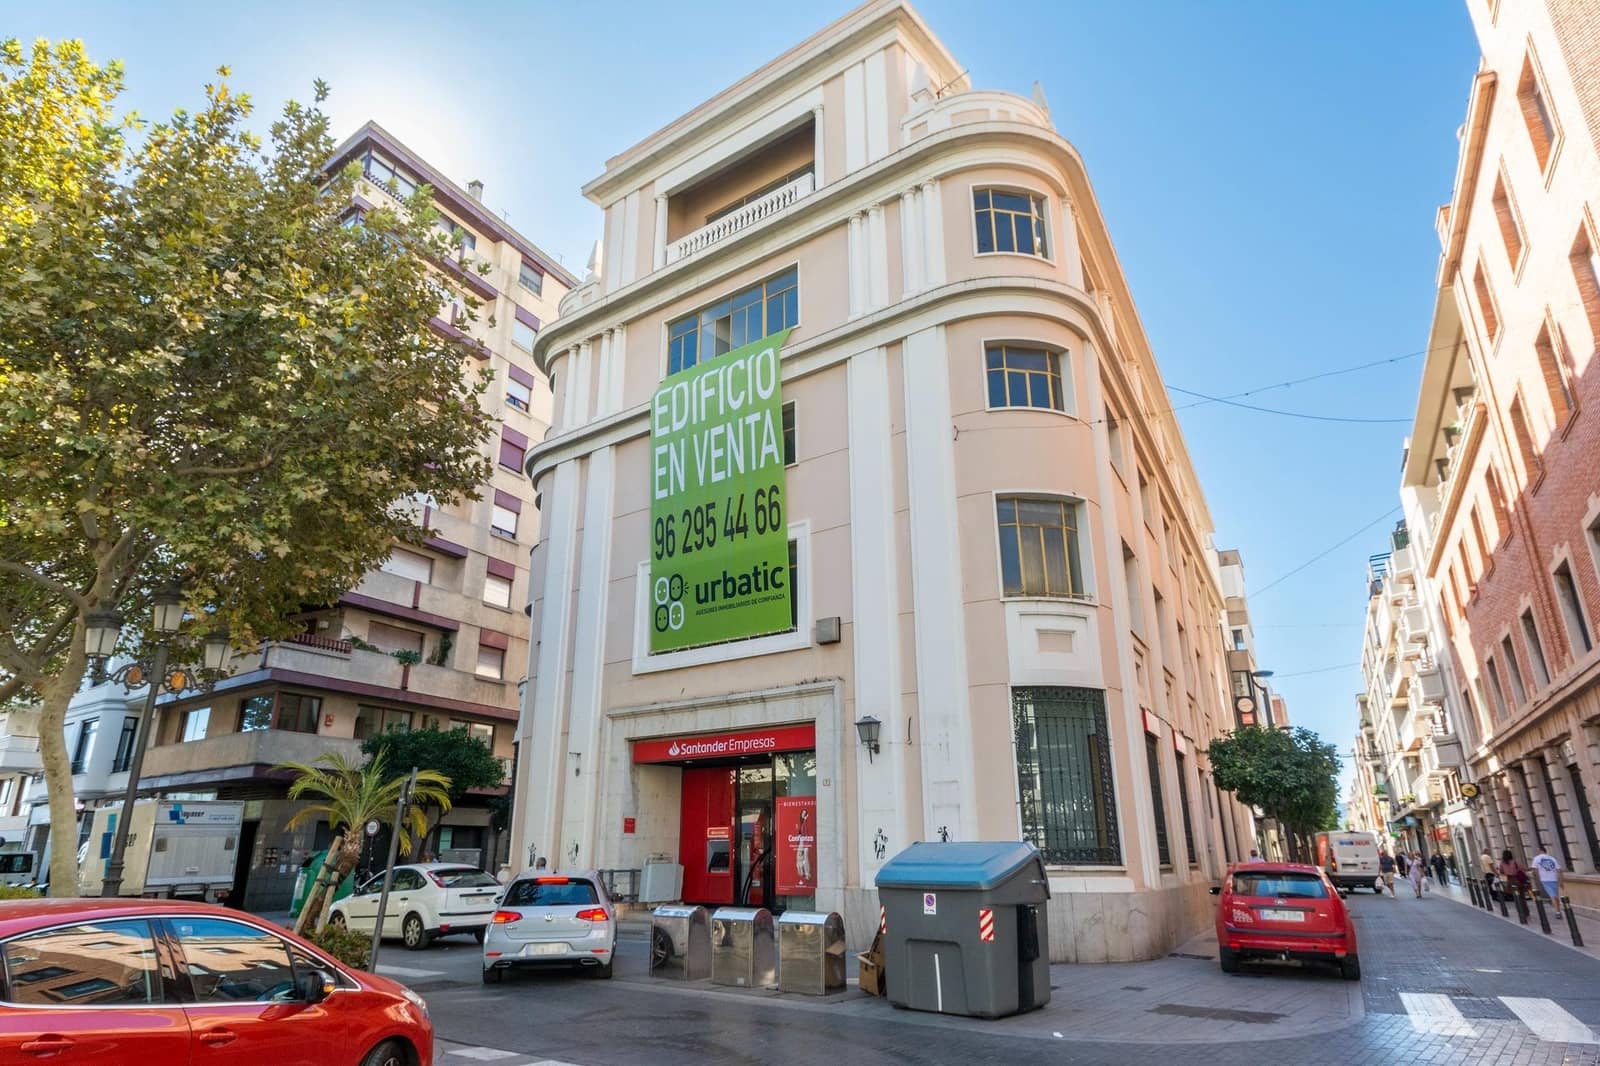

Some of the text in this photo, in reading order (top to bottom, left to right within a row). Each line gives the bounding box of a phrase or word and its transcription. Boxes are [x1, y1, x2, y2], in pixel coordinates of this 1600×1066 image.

[654, 348, 776, 439] EDIFICIO
[655, 408, 780, 500] EN VENTA
[655, 485, 781, 560] 96 295 44 66
[695, 561, 785, 605] urbatic
[680, 737, 776, 756] Santander Empresas
